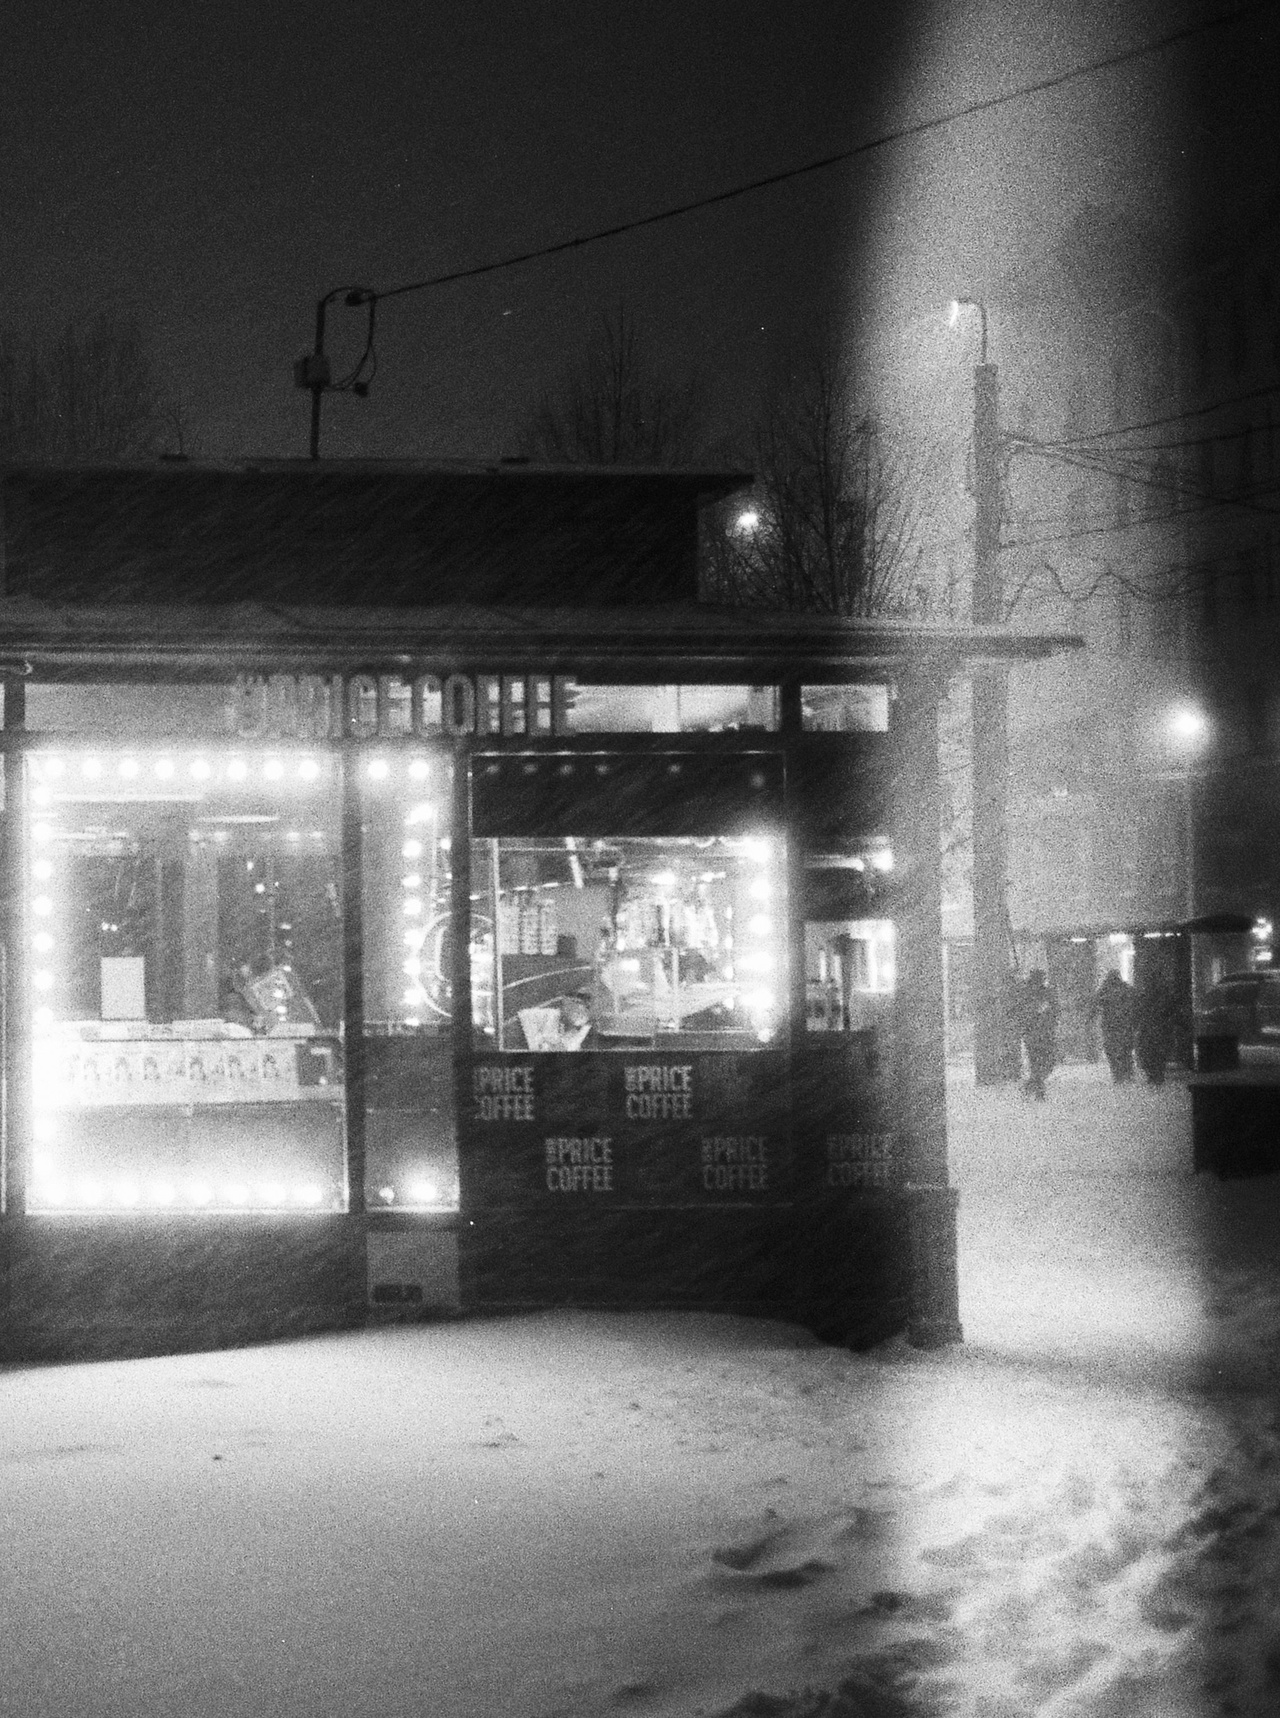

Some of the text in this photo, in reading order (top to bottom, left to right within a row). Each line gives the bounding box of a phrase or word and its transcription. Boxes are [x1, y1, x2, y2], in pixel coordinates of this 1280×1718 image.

[414, 674, 577, 737] COFFEE
[480, 1066, 535, 1092] PRICE
[638, 1065, 693, 1091] PRICE
[626, 1093, 693, 1119] COFFEE
[558, 1137, 613, 1164] PRICE
[713, 1136, 769, 1162] PRICE
[547, 1165, 614, 1191] COFFEE
[702, 1164, 769, 1190] COFFEE
